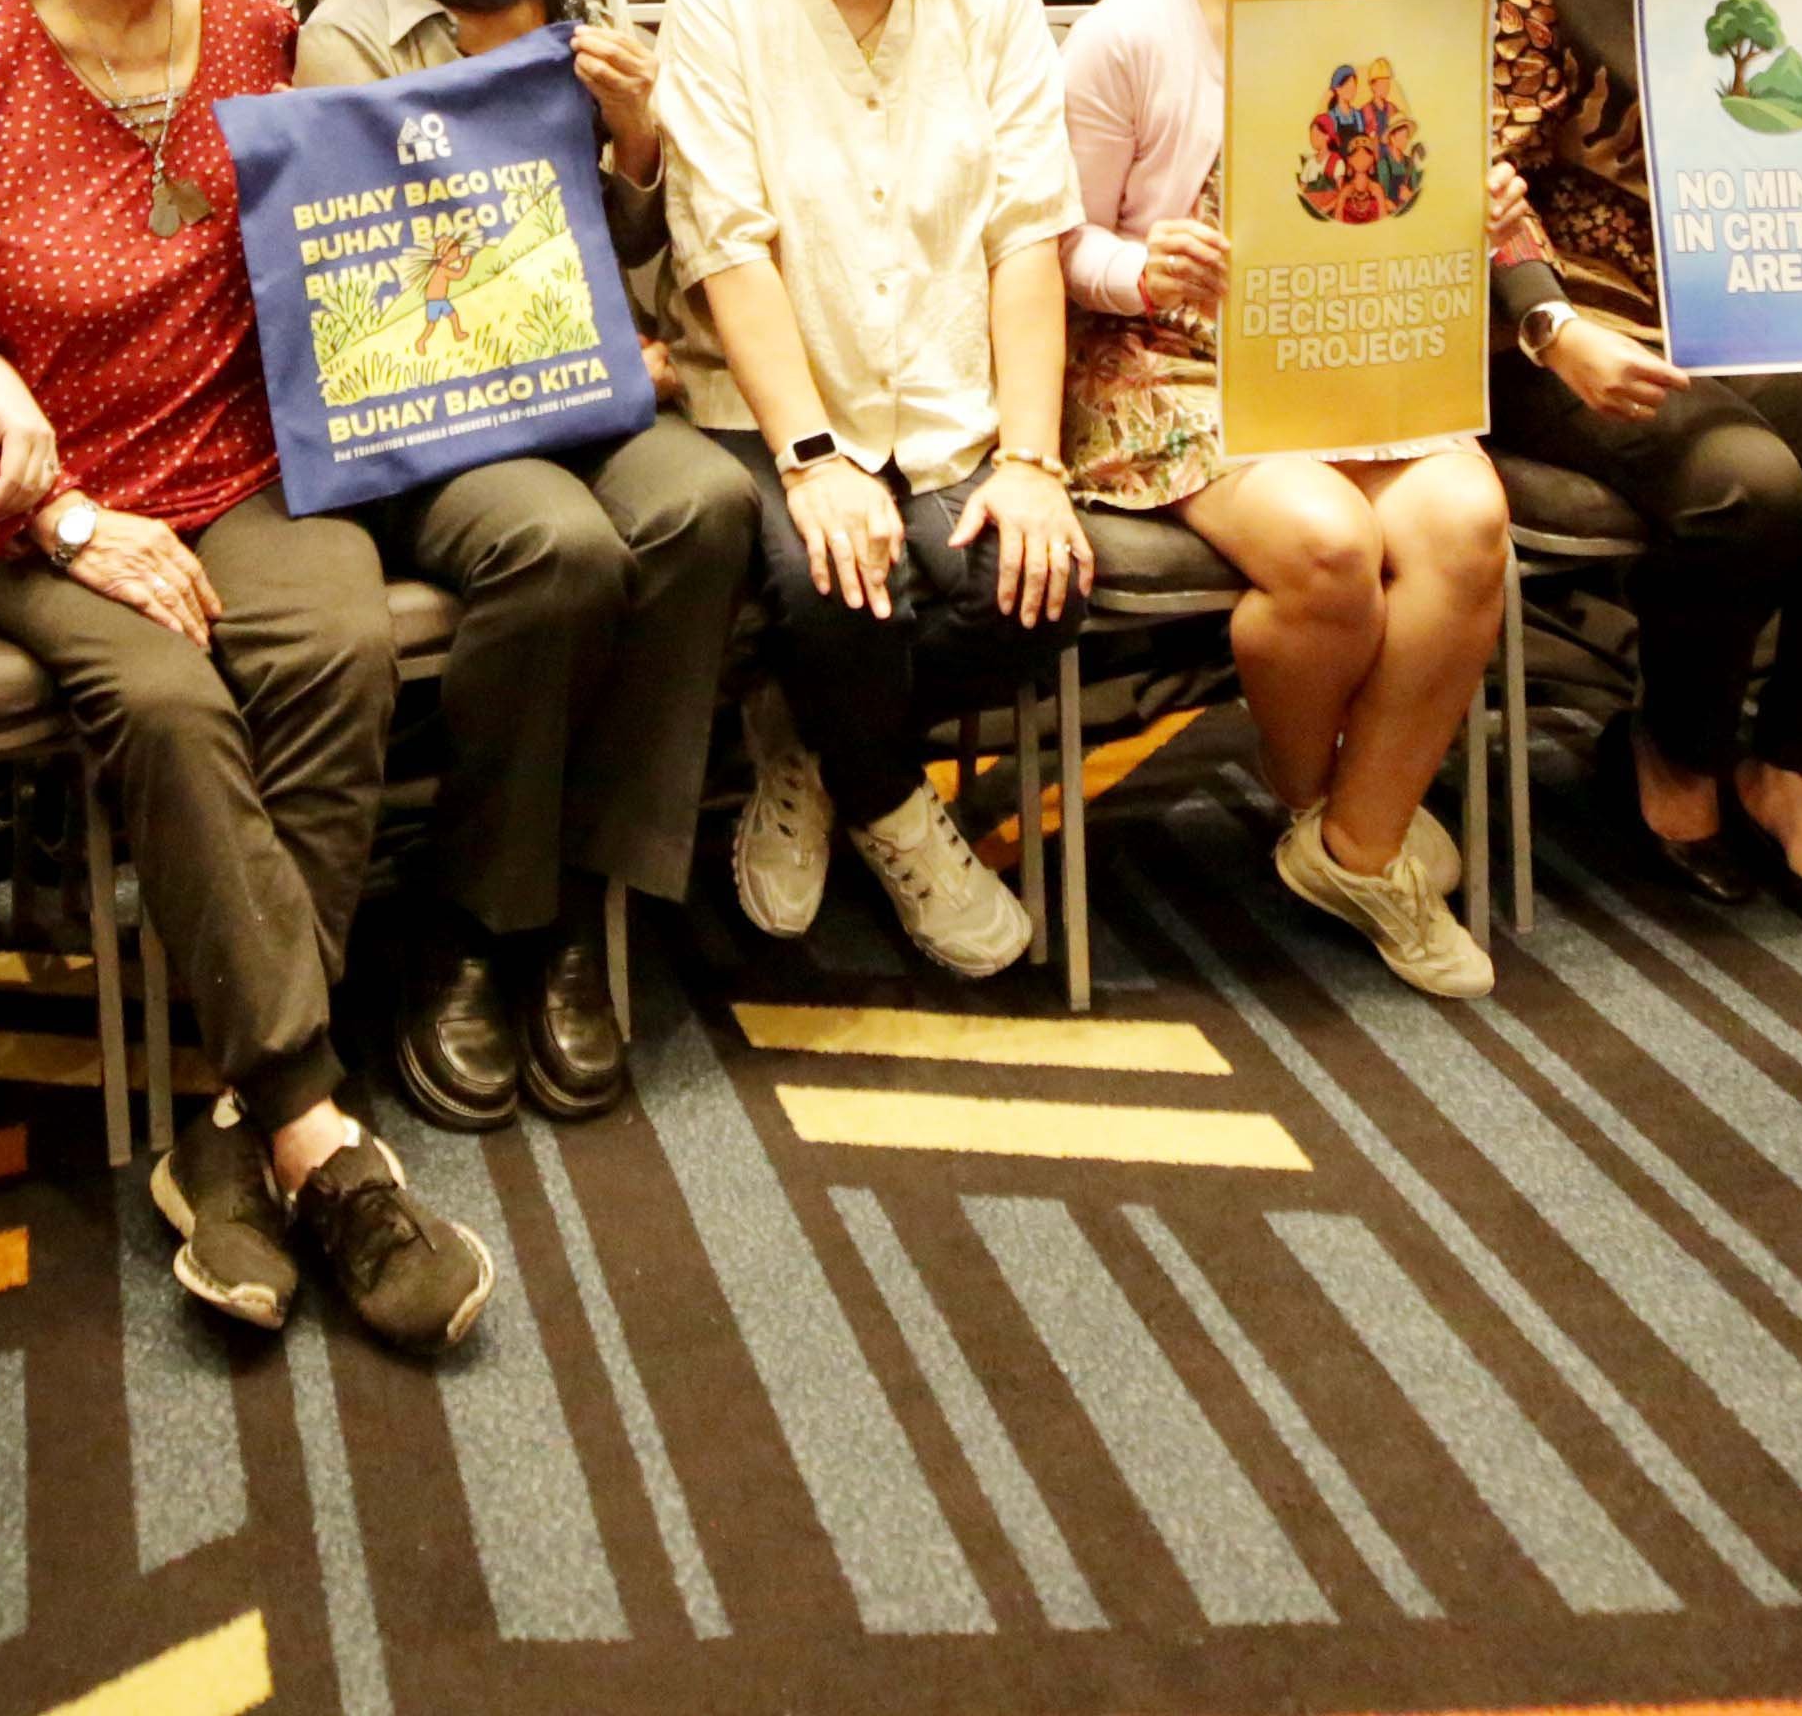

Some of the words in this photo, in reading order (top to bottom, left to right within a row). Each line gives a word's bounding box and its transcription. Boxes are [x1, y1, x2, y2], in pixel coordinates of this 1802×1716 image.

[398, 137, 452, 165] LRC
[293, 186, 396, 231] BUHAY
[404, 170, 490, 208] BAGO
[1676, 170, 1737, 211] NO
[300, 221, 404, 267] BUHAY
[1673, 213, 1715, 254] IN
[1244, 259, 1384, 302] PEOPLE
[1387, 251, 1474, 291] MAKE
[1242, 295, 1425, 338] DECISIONS
[1431, 287, 1473, 324] ON
[1275, 324, 1447, 372] PROJECTS
[328, 396, 437, 444] BUHAY
[444, 373, 535, 418] BAGO
[541, 357, 609, 401] KITA
